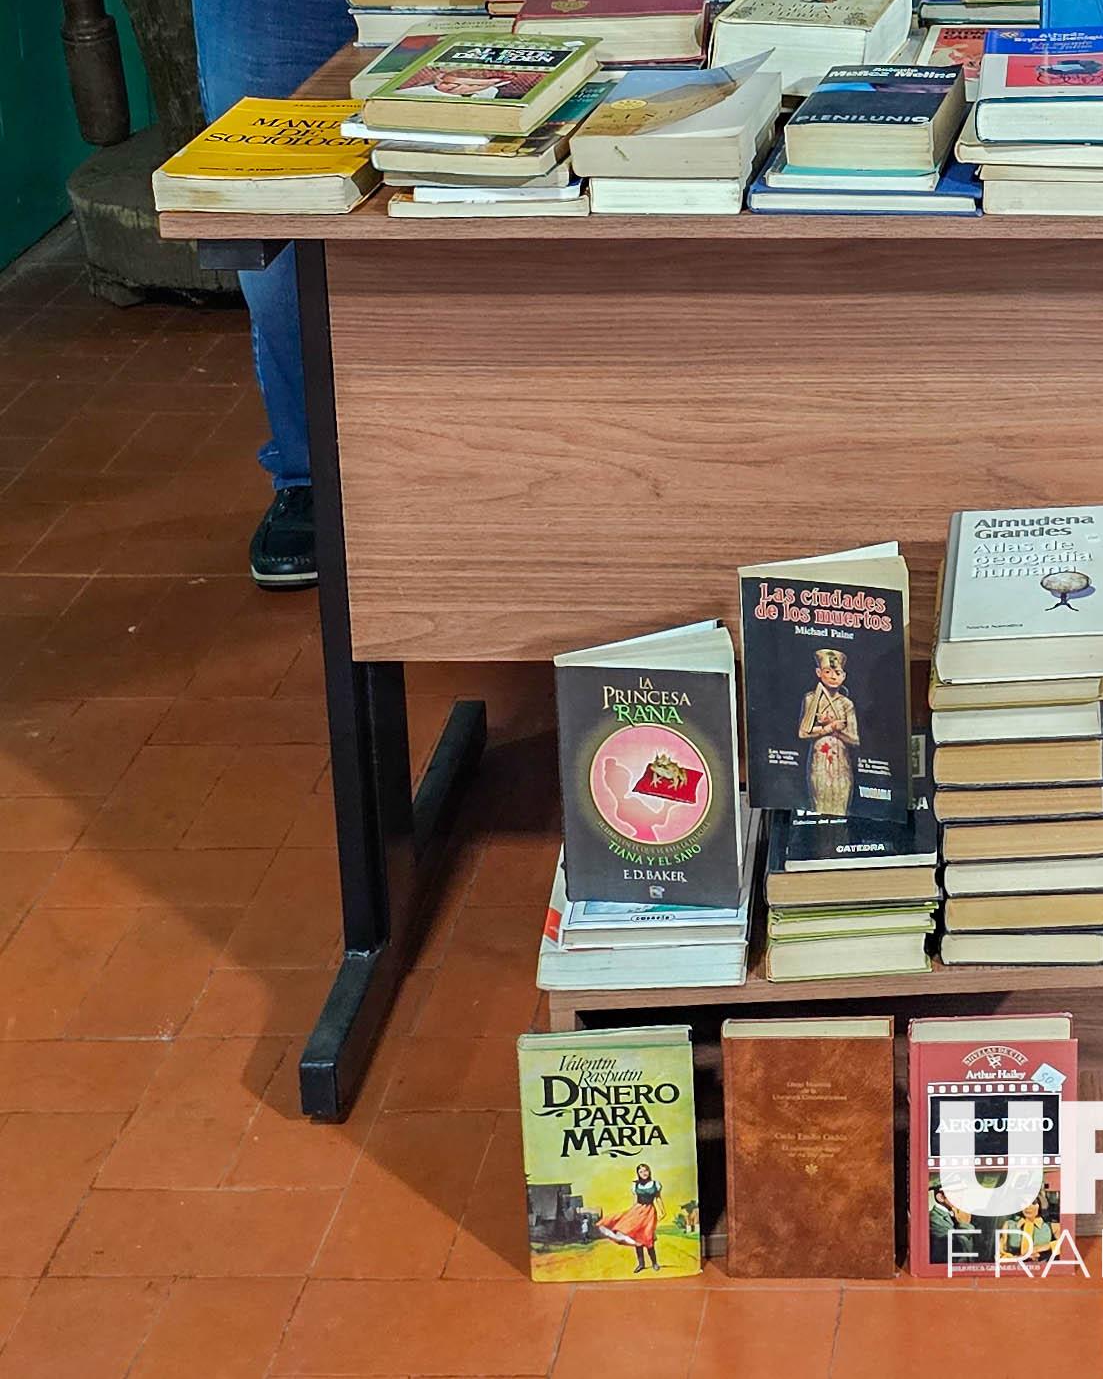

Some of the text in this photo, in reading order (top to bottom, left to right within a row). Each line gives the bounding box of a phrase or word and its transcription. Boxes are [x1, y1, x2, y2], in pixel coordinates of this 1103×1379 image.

[894, 71, 957, 79] Molina
[251, 118, 343, 128] MANU
[796, 114, 931, 123] PLENILUNIO
[276, 128, 325, 137] DE
[974, 515, 1095, 529] Almudena
[974, 526, 1072, 540] Grandes
[1045, 540, 1075, 551] de
[759, 583, 886, 614] Las ciudades
[755, 601, 893, 632] de los muertos
[795, 625, 828, 637] Michael
[638, 676, 653, 690] LA
[603, 686, 692, 710] PRINCESA
[613, 703, 684, 726] RANA
[608, 840, 702, 866] TIANA Y EL SAPO
[836, 843, 885, 854] CATEDRA
[965, 1068, 1026, 1080] Arthur Hailey
[541, 1075, 680, 1108] DINERO
[572, 1105, 653, 1128] PARA
[936, 1117, 1054, 1134] AEROPUERTO
[560, 1125, 669, 1158] MARIA
